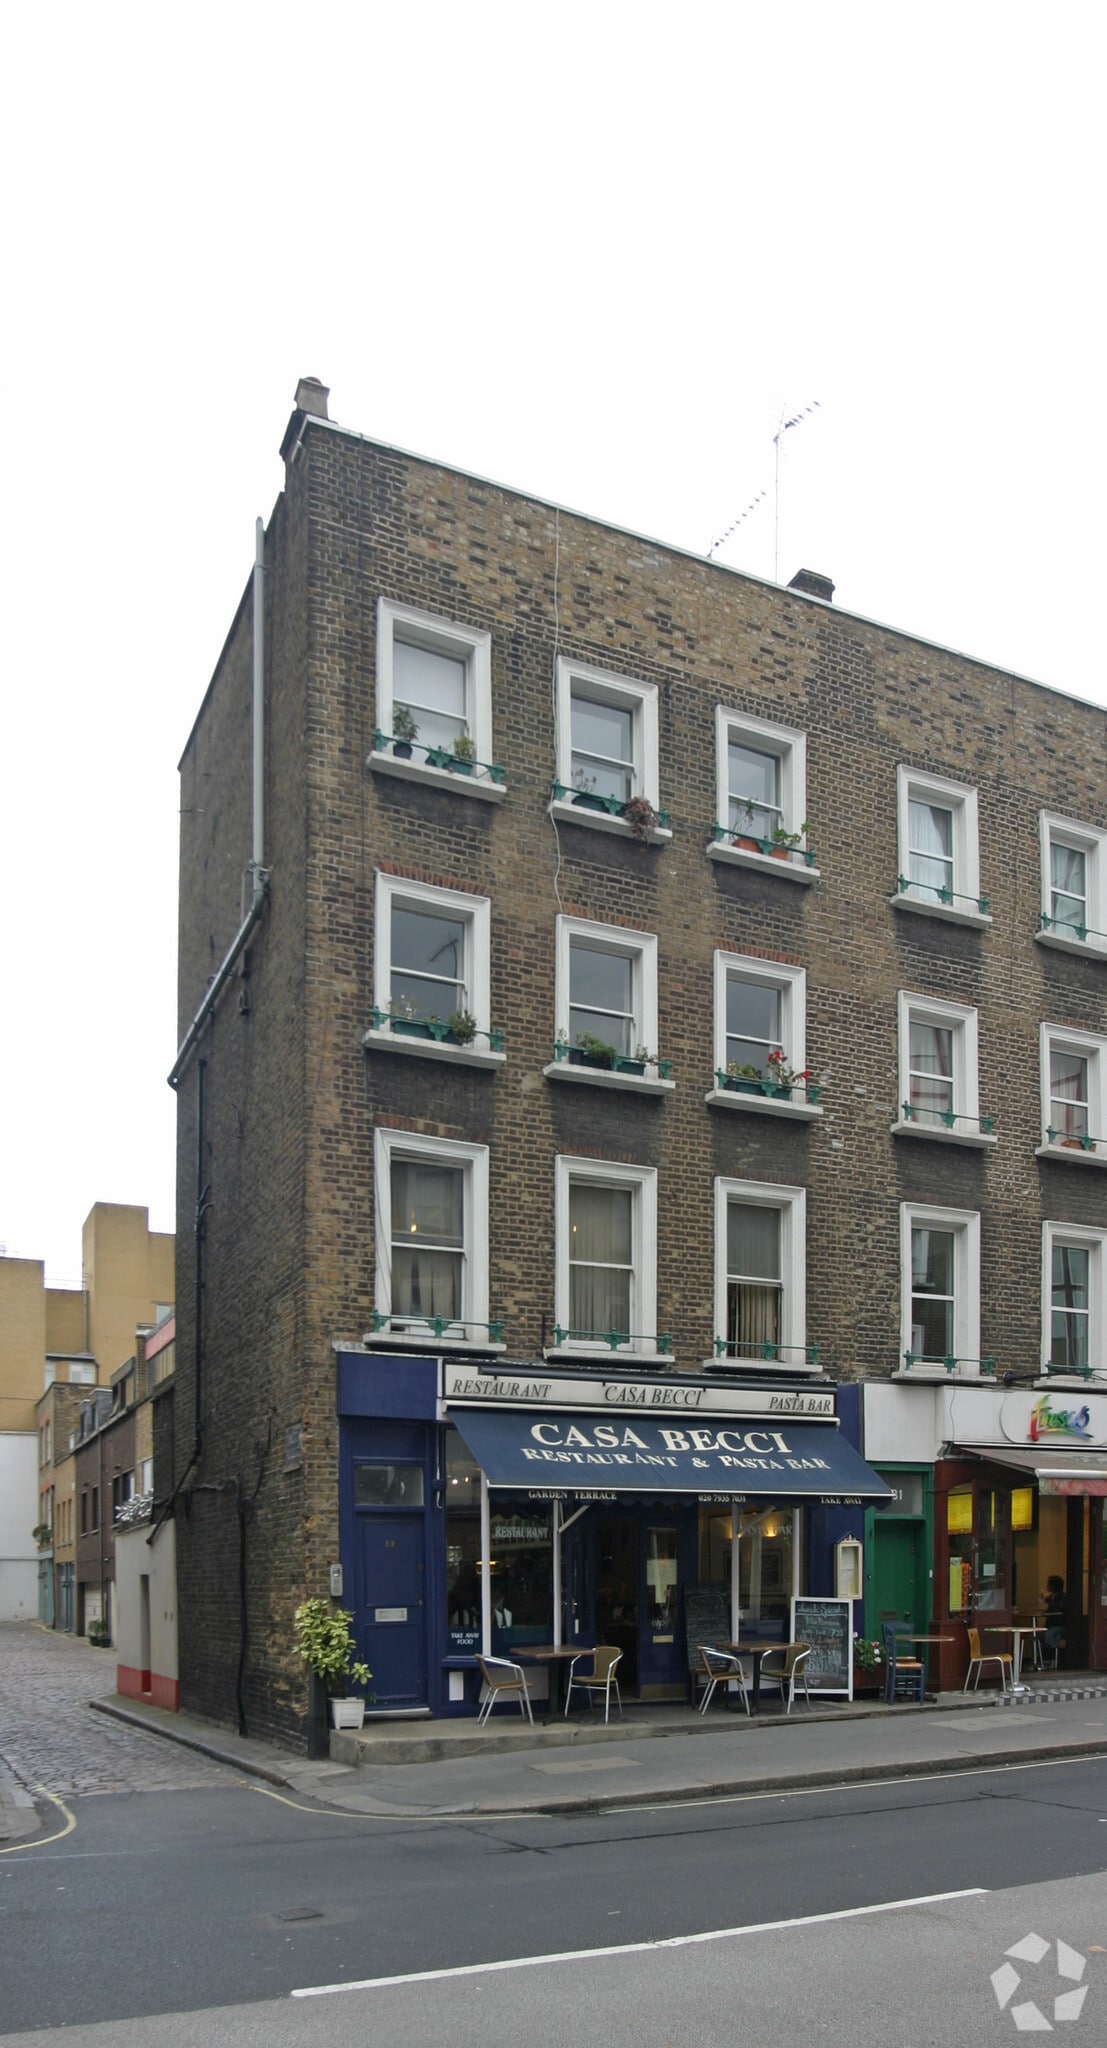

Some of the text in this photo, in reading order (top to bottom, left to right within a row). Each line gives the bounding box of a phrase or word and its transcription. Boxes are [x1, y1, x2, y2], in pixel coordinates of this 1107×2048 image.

[453, 1379, 552, 1398] RESTAURANT
[605, 1385, 702, 1406] CASA BECCI
[769, 1396, 832, 1412] PASTA BAR
[530, 1423, 793, 1454] CASA BECCI
[520, 1448, 832, 1470] RESTAURANT & PASTA BAR
[528, 1490, 617, 1500] GARDEN TERRACE
[820, 1496, 863, 1505] TAKE AWAY
[495, 1526, 549, 1538] RESTAURANT
